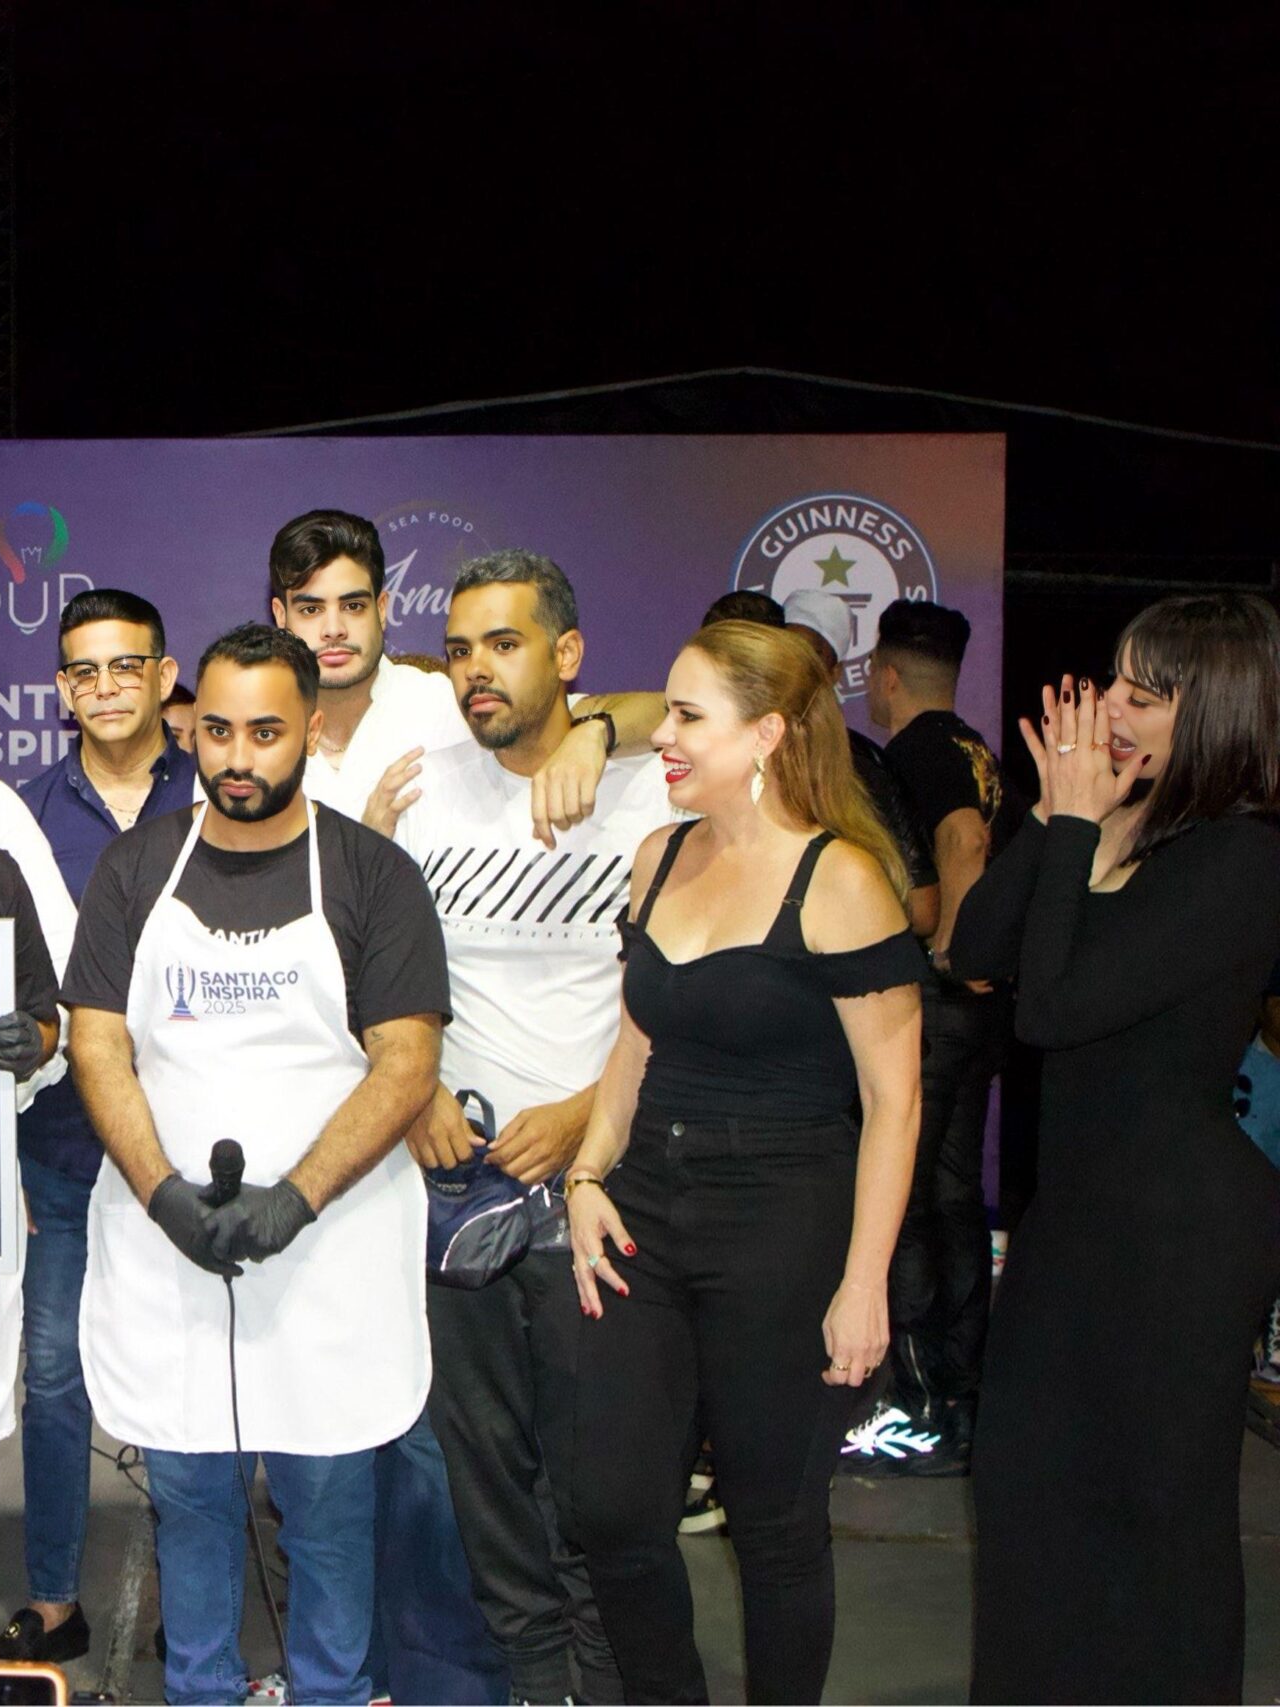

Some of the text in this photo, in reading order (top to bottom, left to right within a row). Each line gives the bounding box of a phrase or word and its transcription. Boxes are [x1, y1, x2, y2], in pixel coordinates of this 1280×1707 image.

[389, 512, 473, 532] SEA FOOD
[761, 505, 912, 561] GUINNESS
[200, 970, 298, 986] SANTIAGO
[202, 986, 280, 1000] INSPIRA
[204, 1000, 246, 1014] 2025
